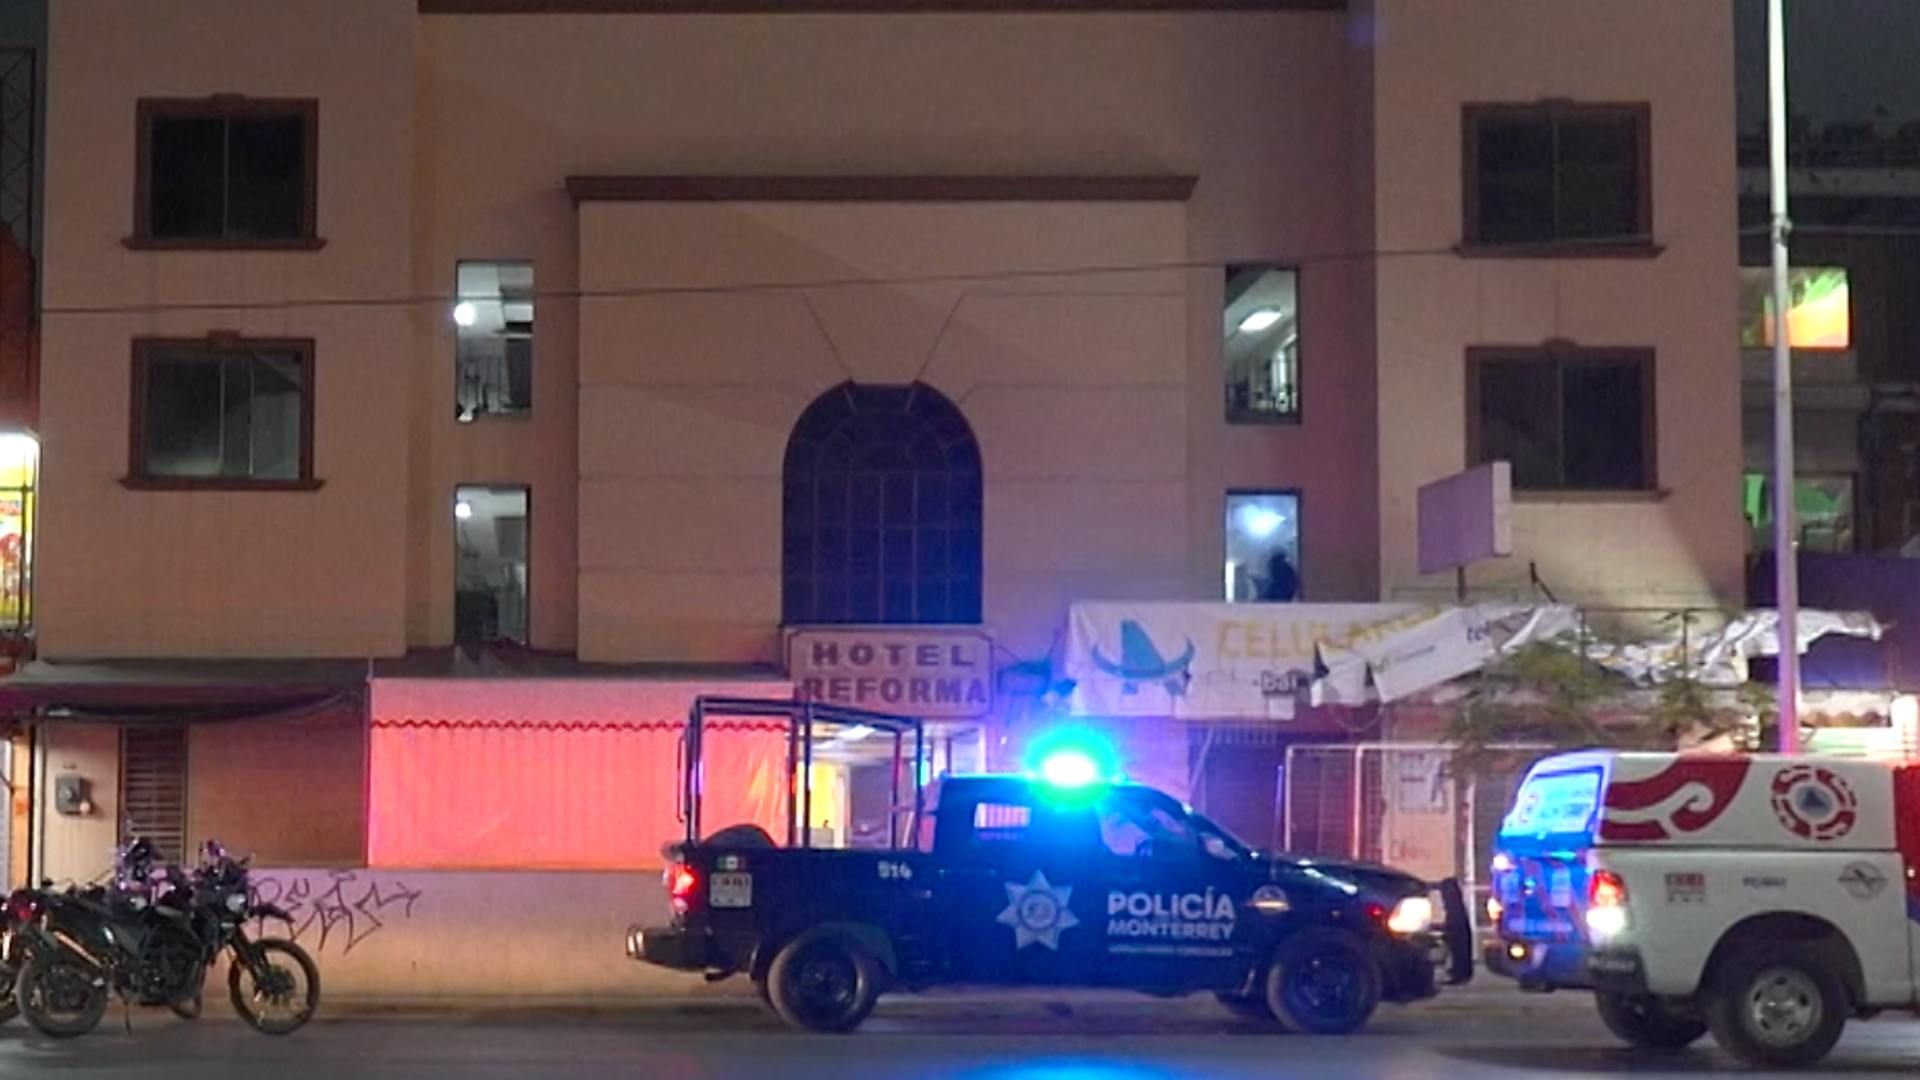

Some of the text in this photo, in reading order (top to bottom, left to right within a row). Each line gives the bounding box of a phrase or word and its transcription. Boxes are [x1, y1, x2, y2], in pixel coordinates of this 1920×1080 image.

[812, 642, 974, 667] HOTEL
[803, 677, 986, 703] REFORMA
[1107, 886, 1235, 920] POLICÍA
[1107, 918, 1234, 940] MONTERREY
